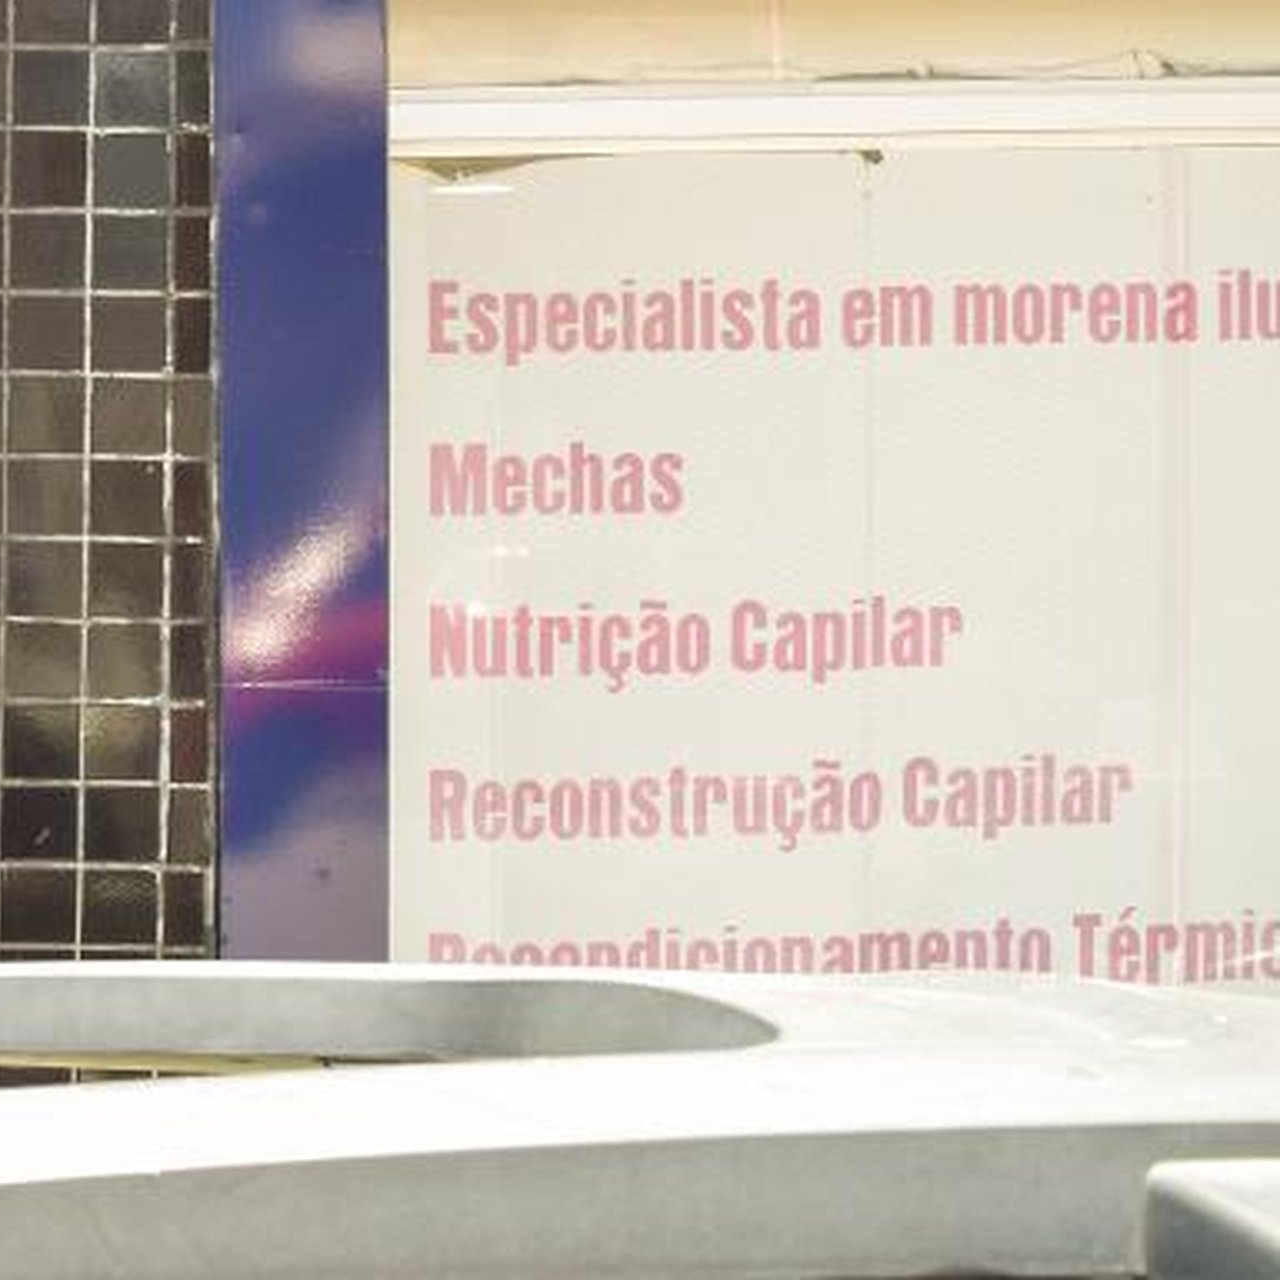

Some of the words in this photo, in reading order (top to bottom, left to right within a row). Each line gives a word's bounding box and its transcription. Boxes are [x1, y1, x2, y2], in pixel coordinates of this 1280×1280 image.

[426, 274, 824, 366] Especialista
[842, 282, 934, 349] em
[952, 276, 1199, 348] morena
[427, 440, 686, 518] Mechas
[427, 598, 712, 695] Nutrição
[728, 593, 963, 684] Capilar
[426, 758, 884, 852] Reconstrução
[902, 752, 1135, 841] Capilar
